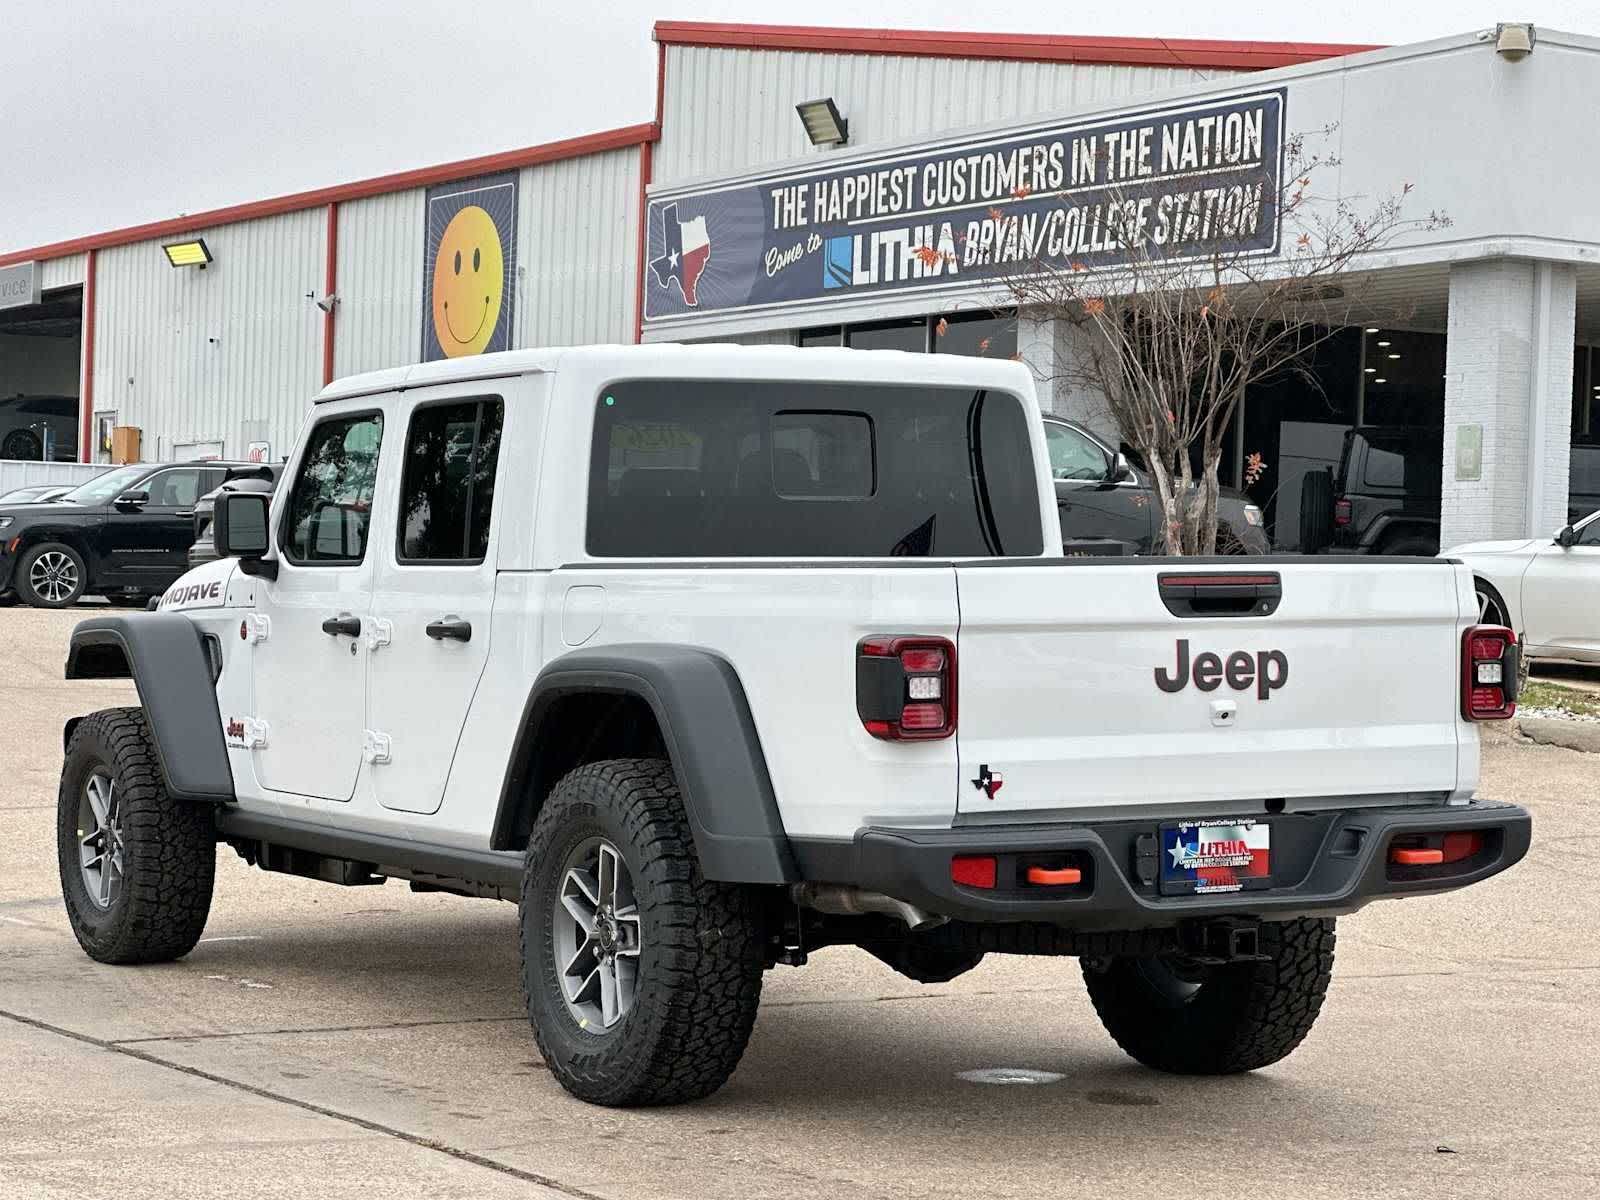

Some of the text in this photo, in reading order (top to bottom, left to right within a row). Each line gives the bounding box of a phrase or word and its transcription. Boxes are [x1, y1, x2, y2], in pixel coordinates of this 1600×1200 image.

[771, 108, 1264, 229] THE HAPPIEST CUSTOMERS IN THE NATION
[764, 182, 1264, 286] Come to LITHIA BRYAN/COLLEGE STATION
[160, 581, 222, 606] MOJAVE
[1154, 639, 1289, 700] Jeep
[227, 716, 245, 742] Jeep
[1200, 840, 1249, 857] LITHIA
